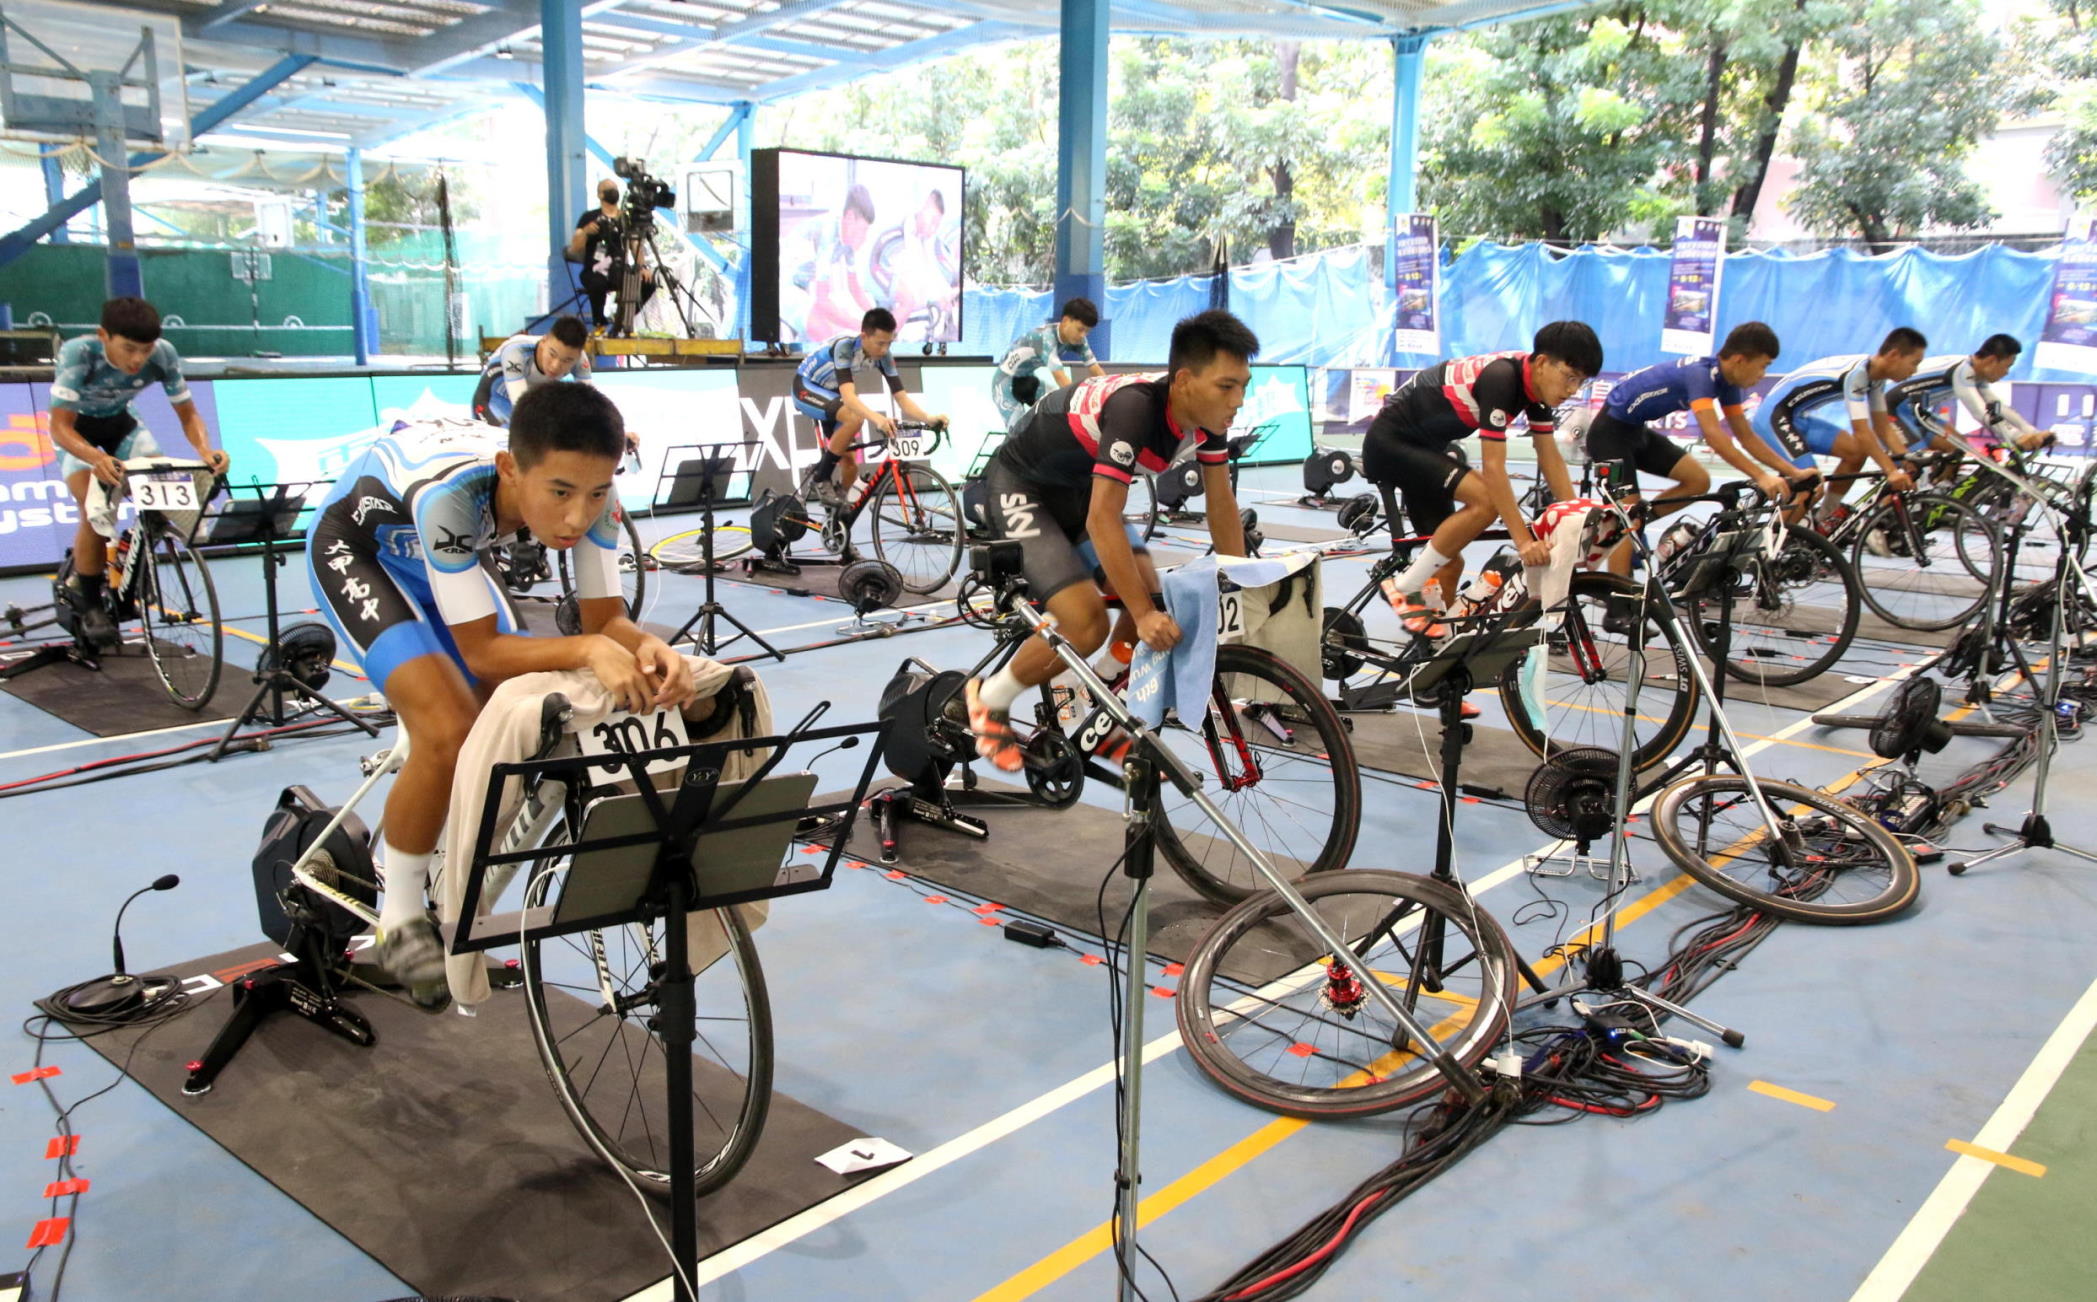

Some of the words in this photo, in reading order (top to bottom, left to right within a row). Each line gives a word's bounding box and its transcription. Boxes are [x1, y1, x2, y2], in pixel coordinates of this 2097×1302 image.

[140, 485, 191, 506] 313
[324, 539, 380, 622] 大甲高中
[1673, 642, 1689, 673] SWISS
[1135, 676, 1160, 702] 6th
[1679, 675, 1689, 693] DT
